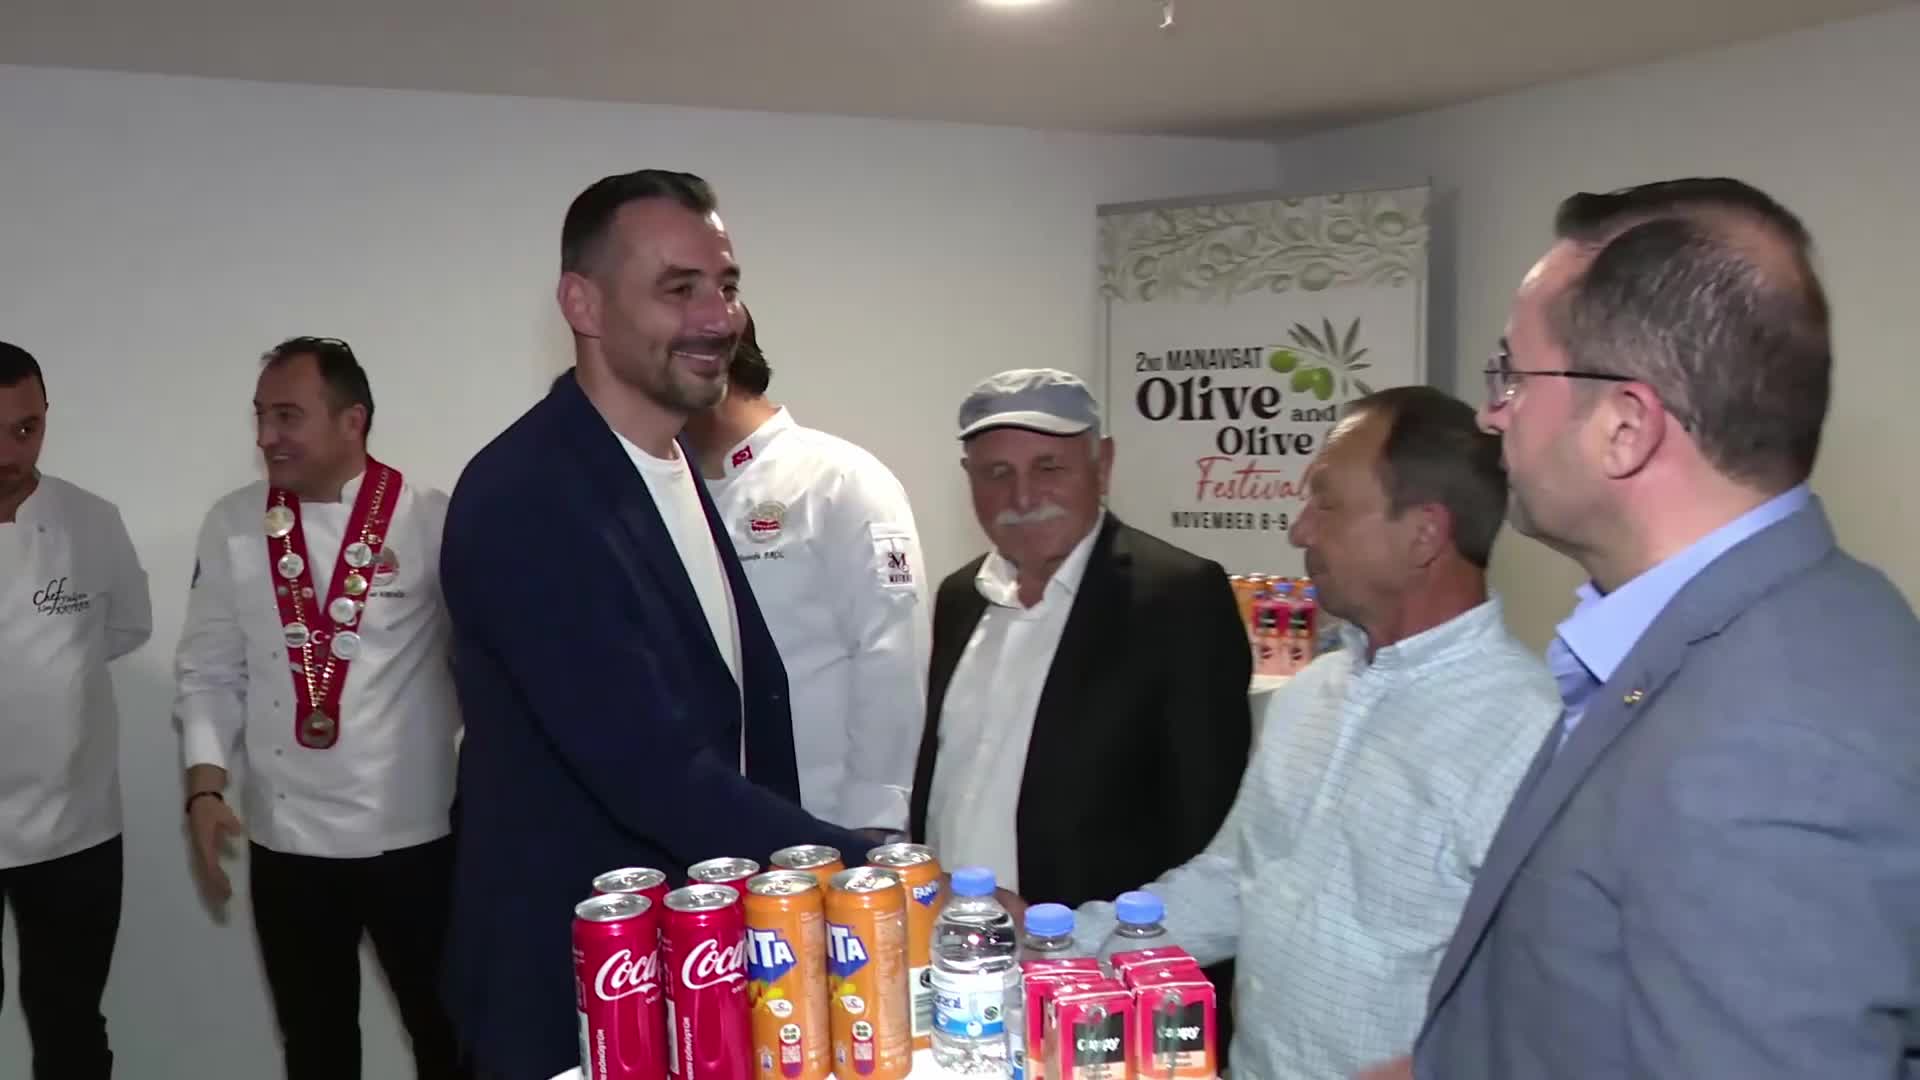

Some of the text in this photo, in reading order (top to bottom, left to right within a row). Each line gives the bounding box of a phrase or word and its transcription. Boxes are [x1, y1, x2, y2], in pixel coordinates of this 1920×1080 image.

[1166, 347, 1263, 371] MANAVGAT
[1136, 375, 1336, 422] Olive and
[1216, 425, 1313, 455] Olive
[1196, 456, 1312, 501] Festival
[1171, 511, 1255, 530] NOVEMBER
